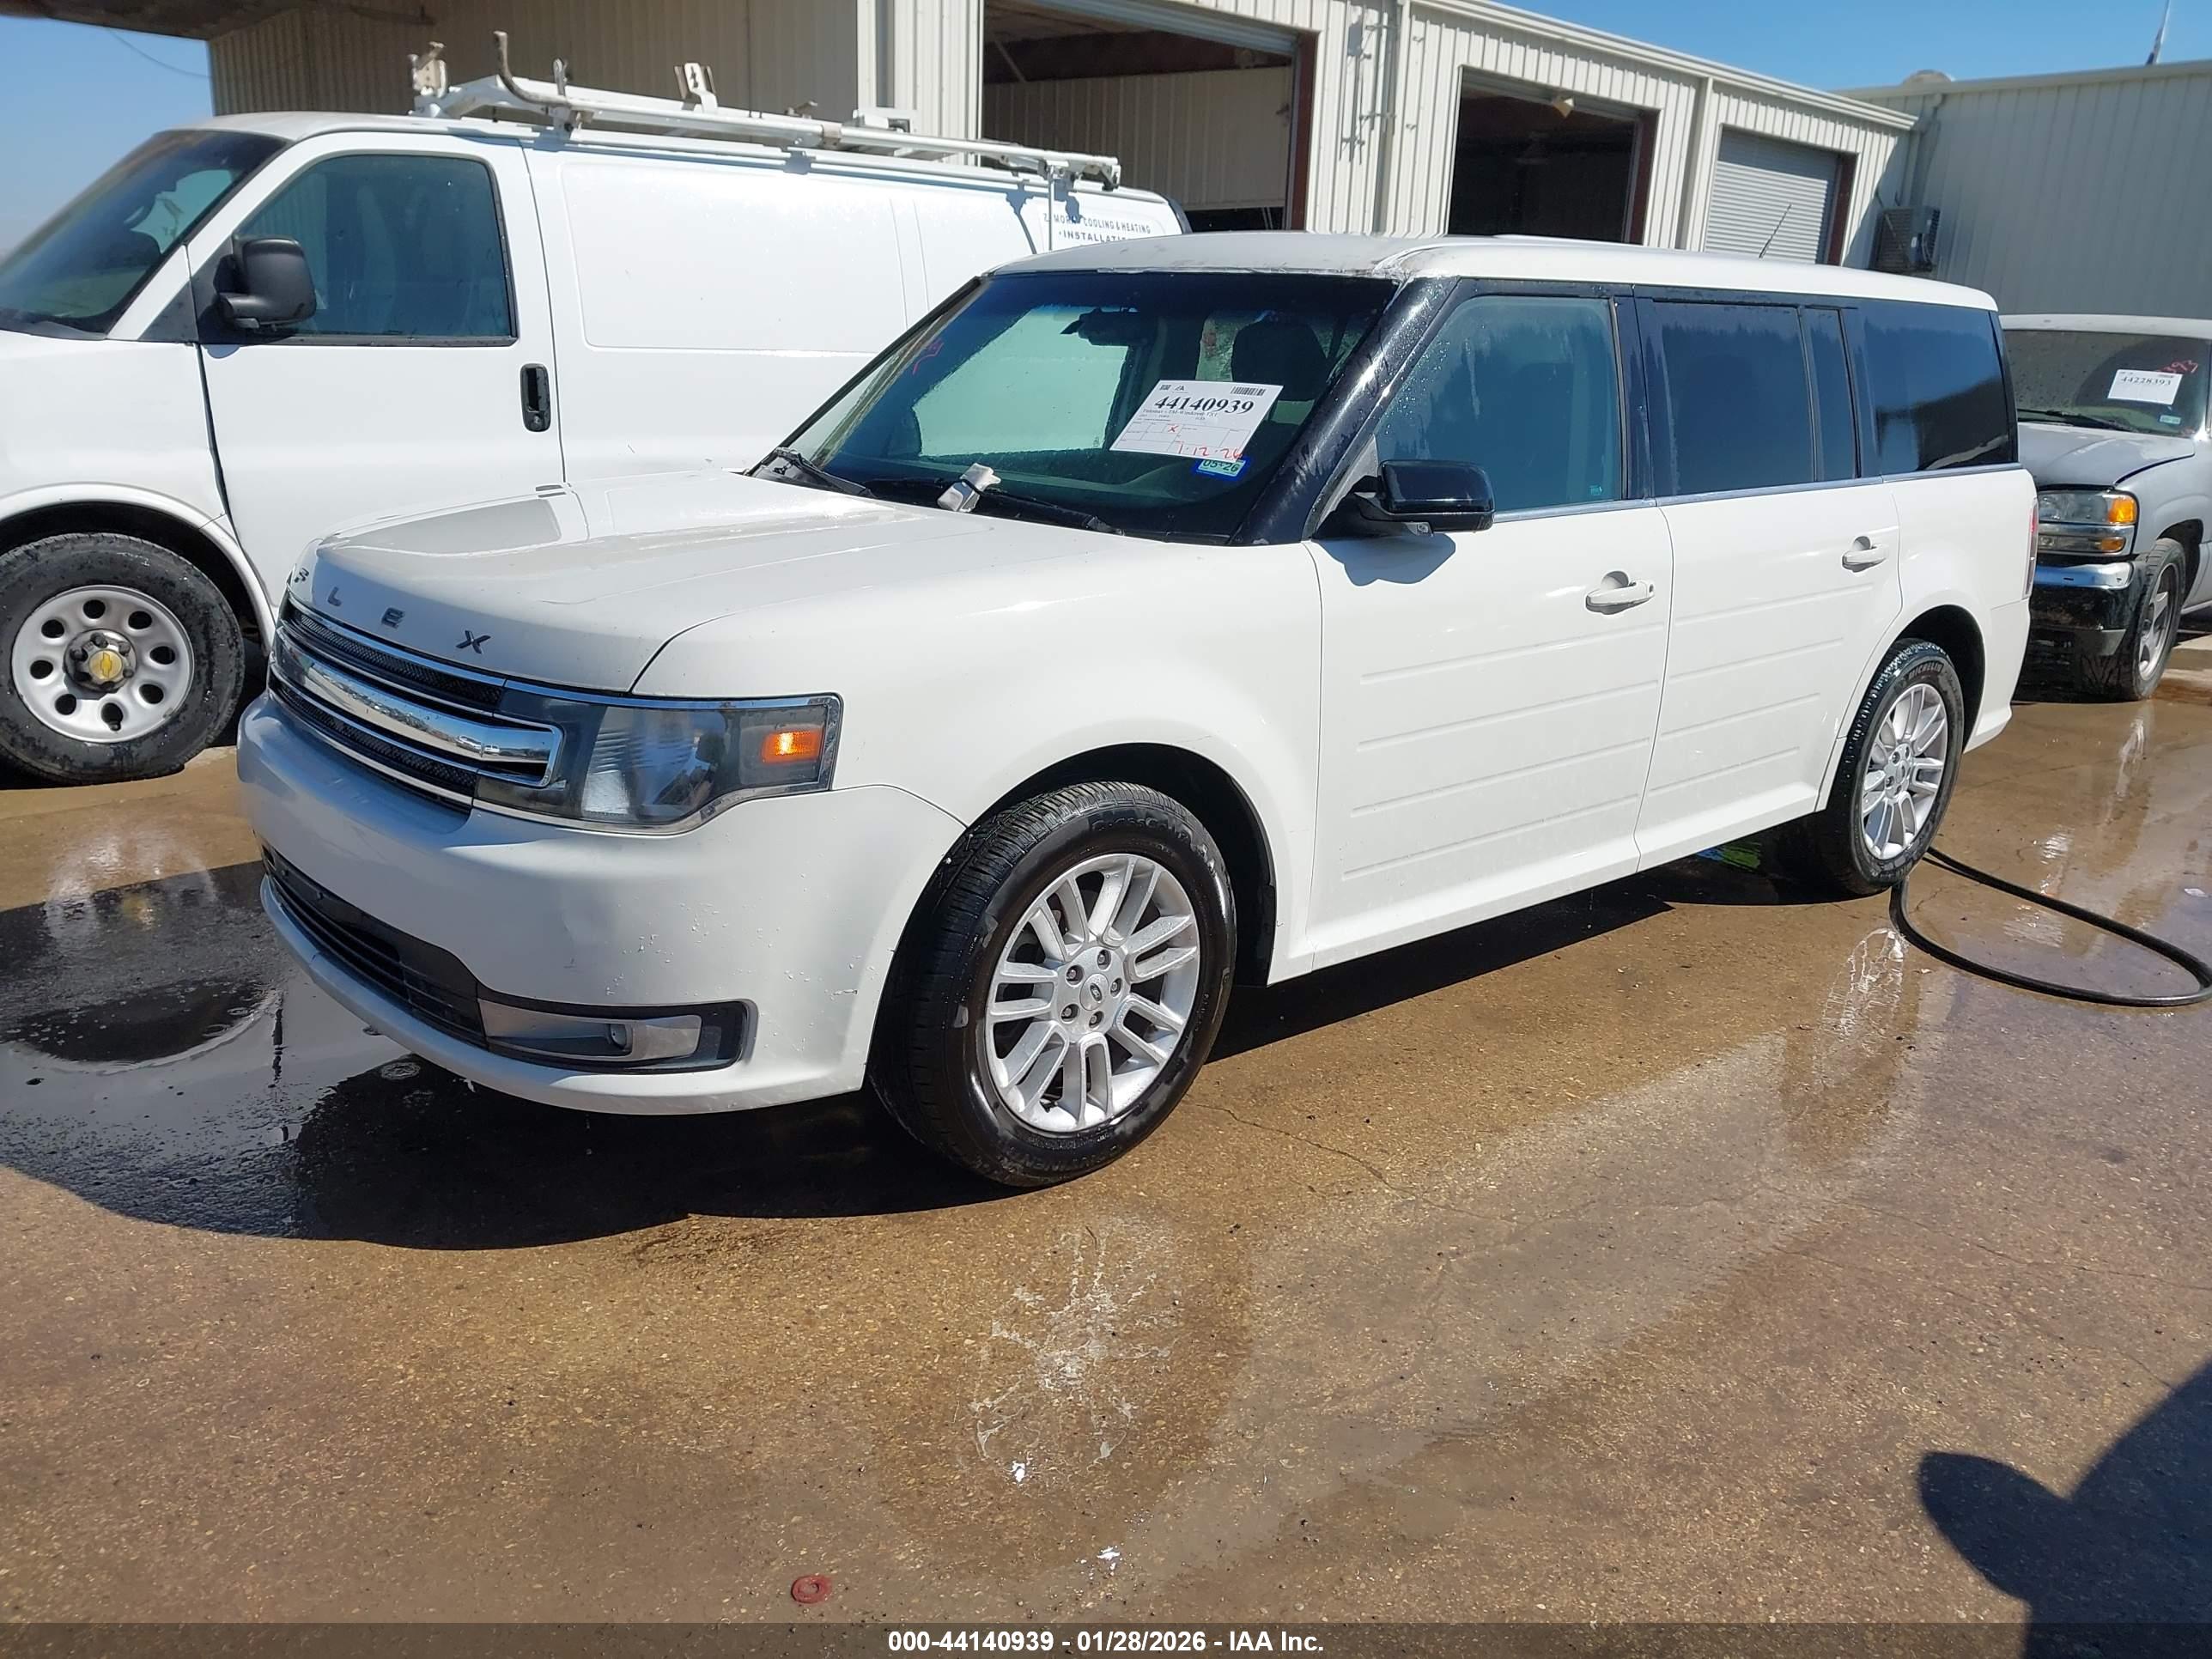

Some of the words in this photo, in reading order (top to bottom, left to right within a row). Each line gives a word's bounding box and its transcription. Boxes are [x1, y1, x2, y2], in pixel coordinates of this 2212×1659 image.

[1083, 217, 1115, 230] COOLING
[1121, 222, 1152, 234] HEATING
[1155, 395, 1255, 415] 44140939
